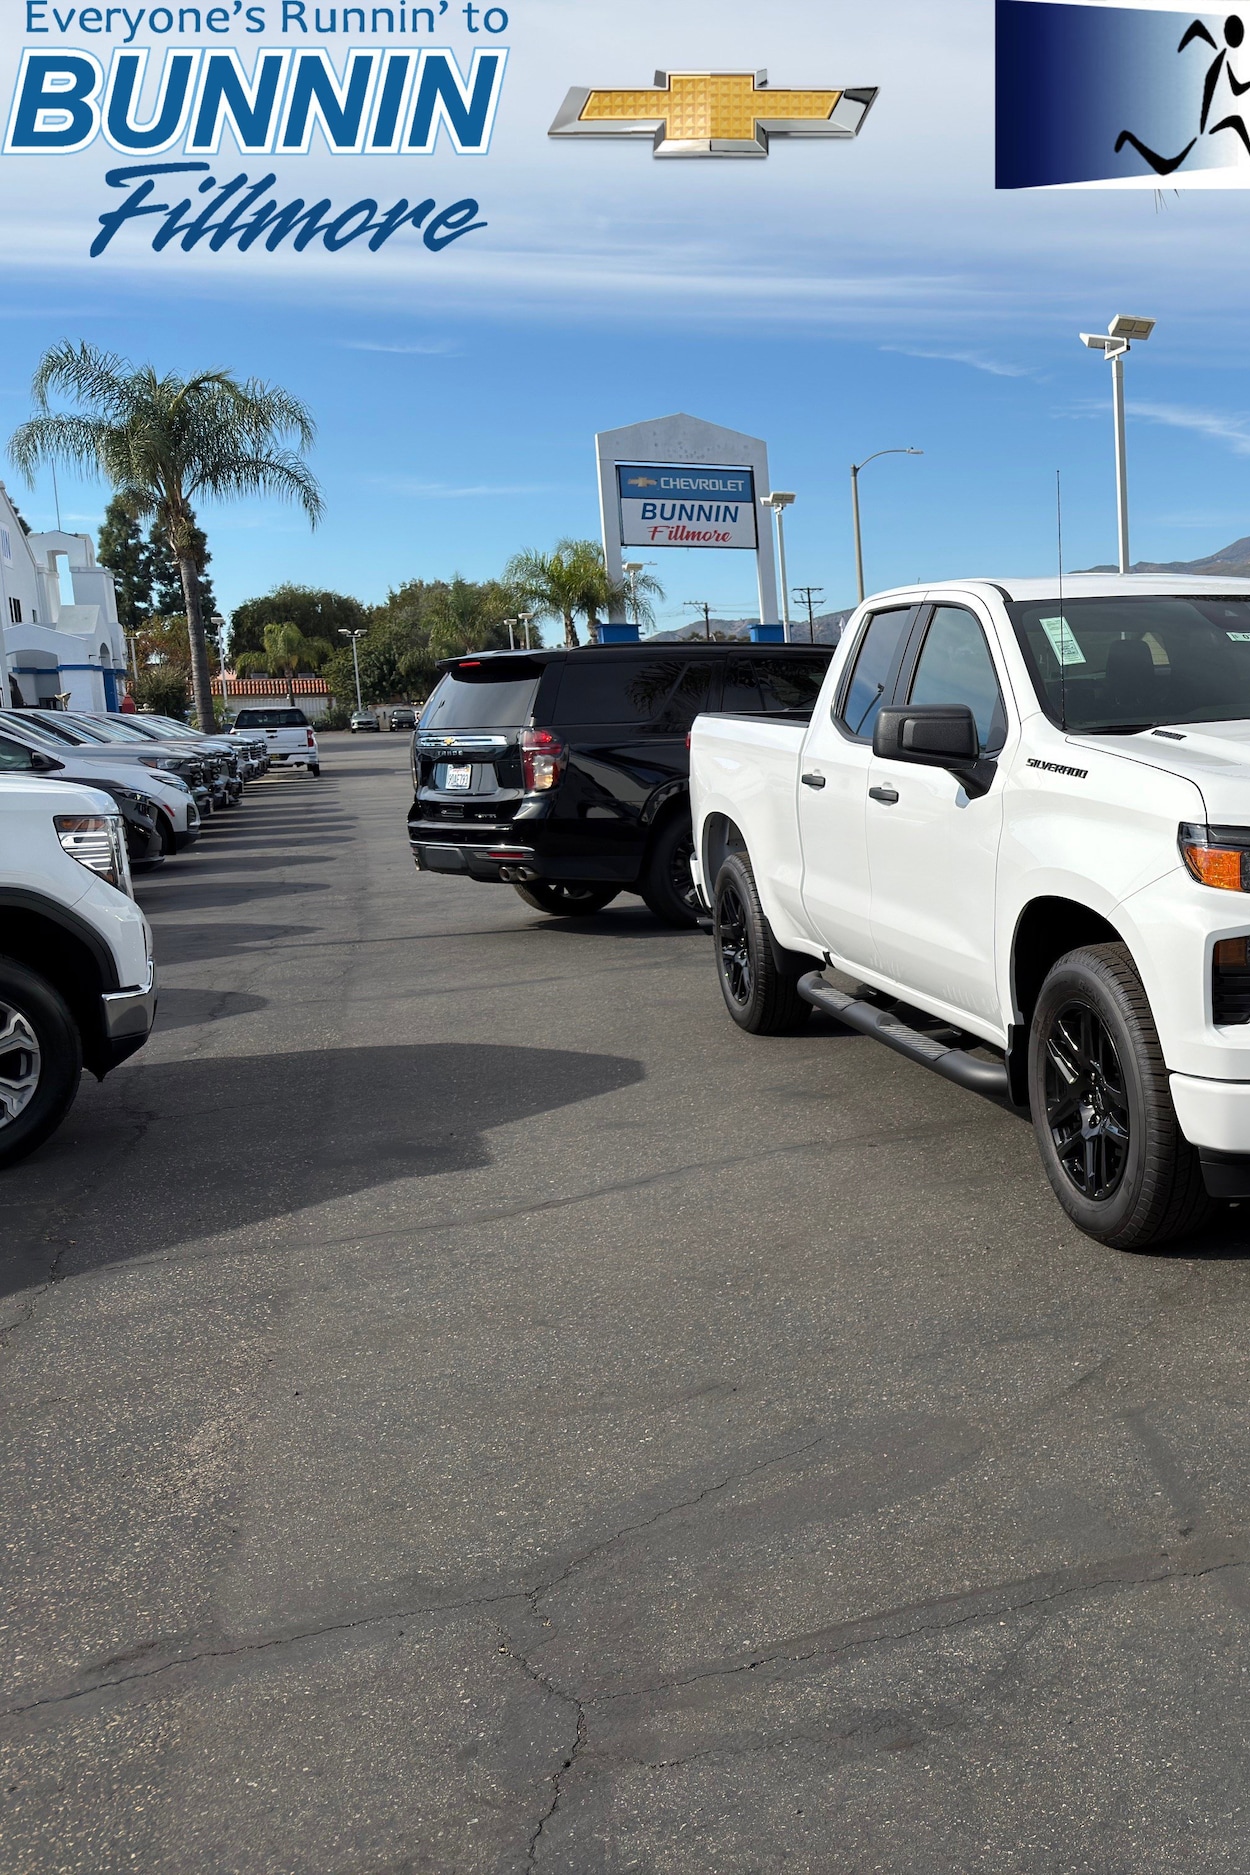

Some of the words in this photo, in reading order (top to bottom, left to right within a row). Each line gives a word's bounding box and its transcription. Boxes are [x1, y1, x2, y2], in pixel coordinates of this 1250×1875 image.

[660, 477, 745, 492] CHEVROLET
[641, 502, 739, 523] BUNNIN
[647, 525, 733, 543] Fillmore
[1025, 758, 1089, 779] SILVERADO
